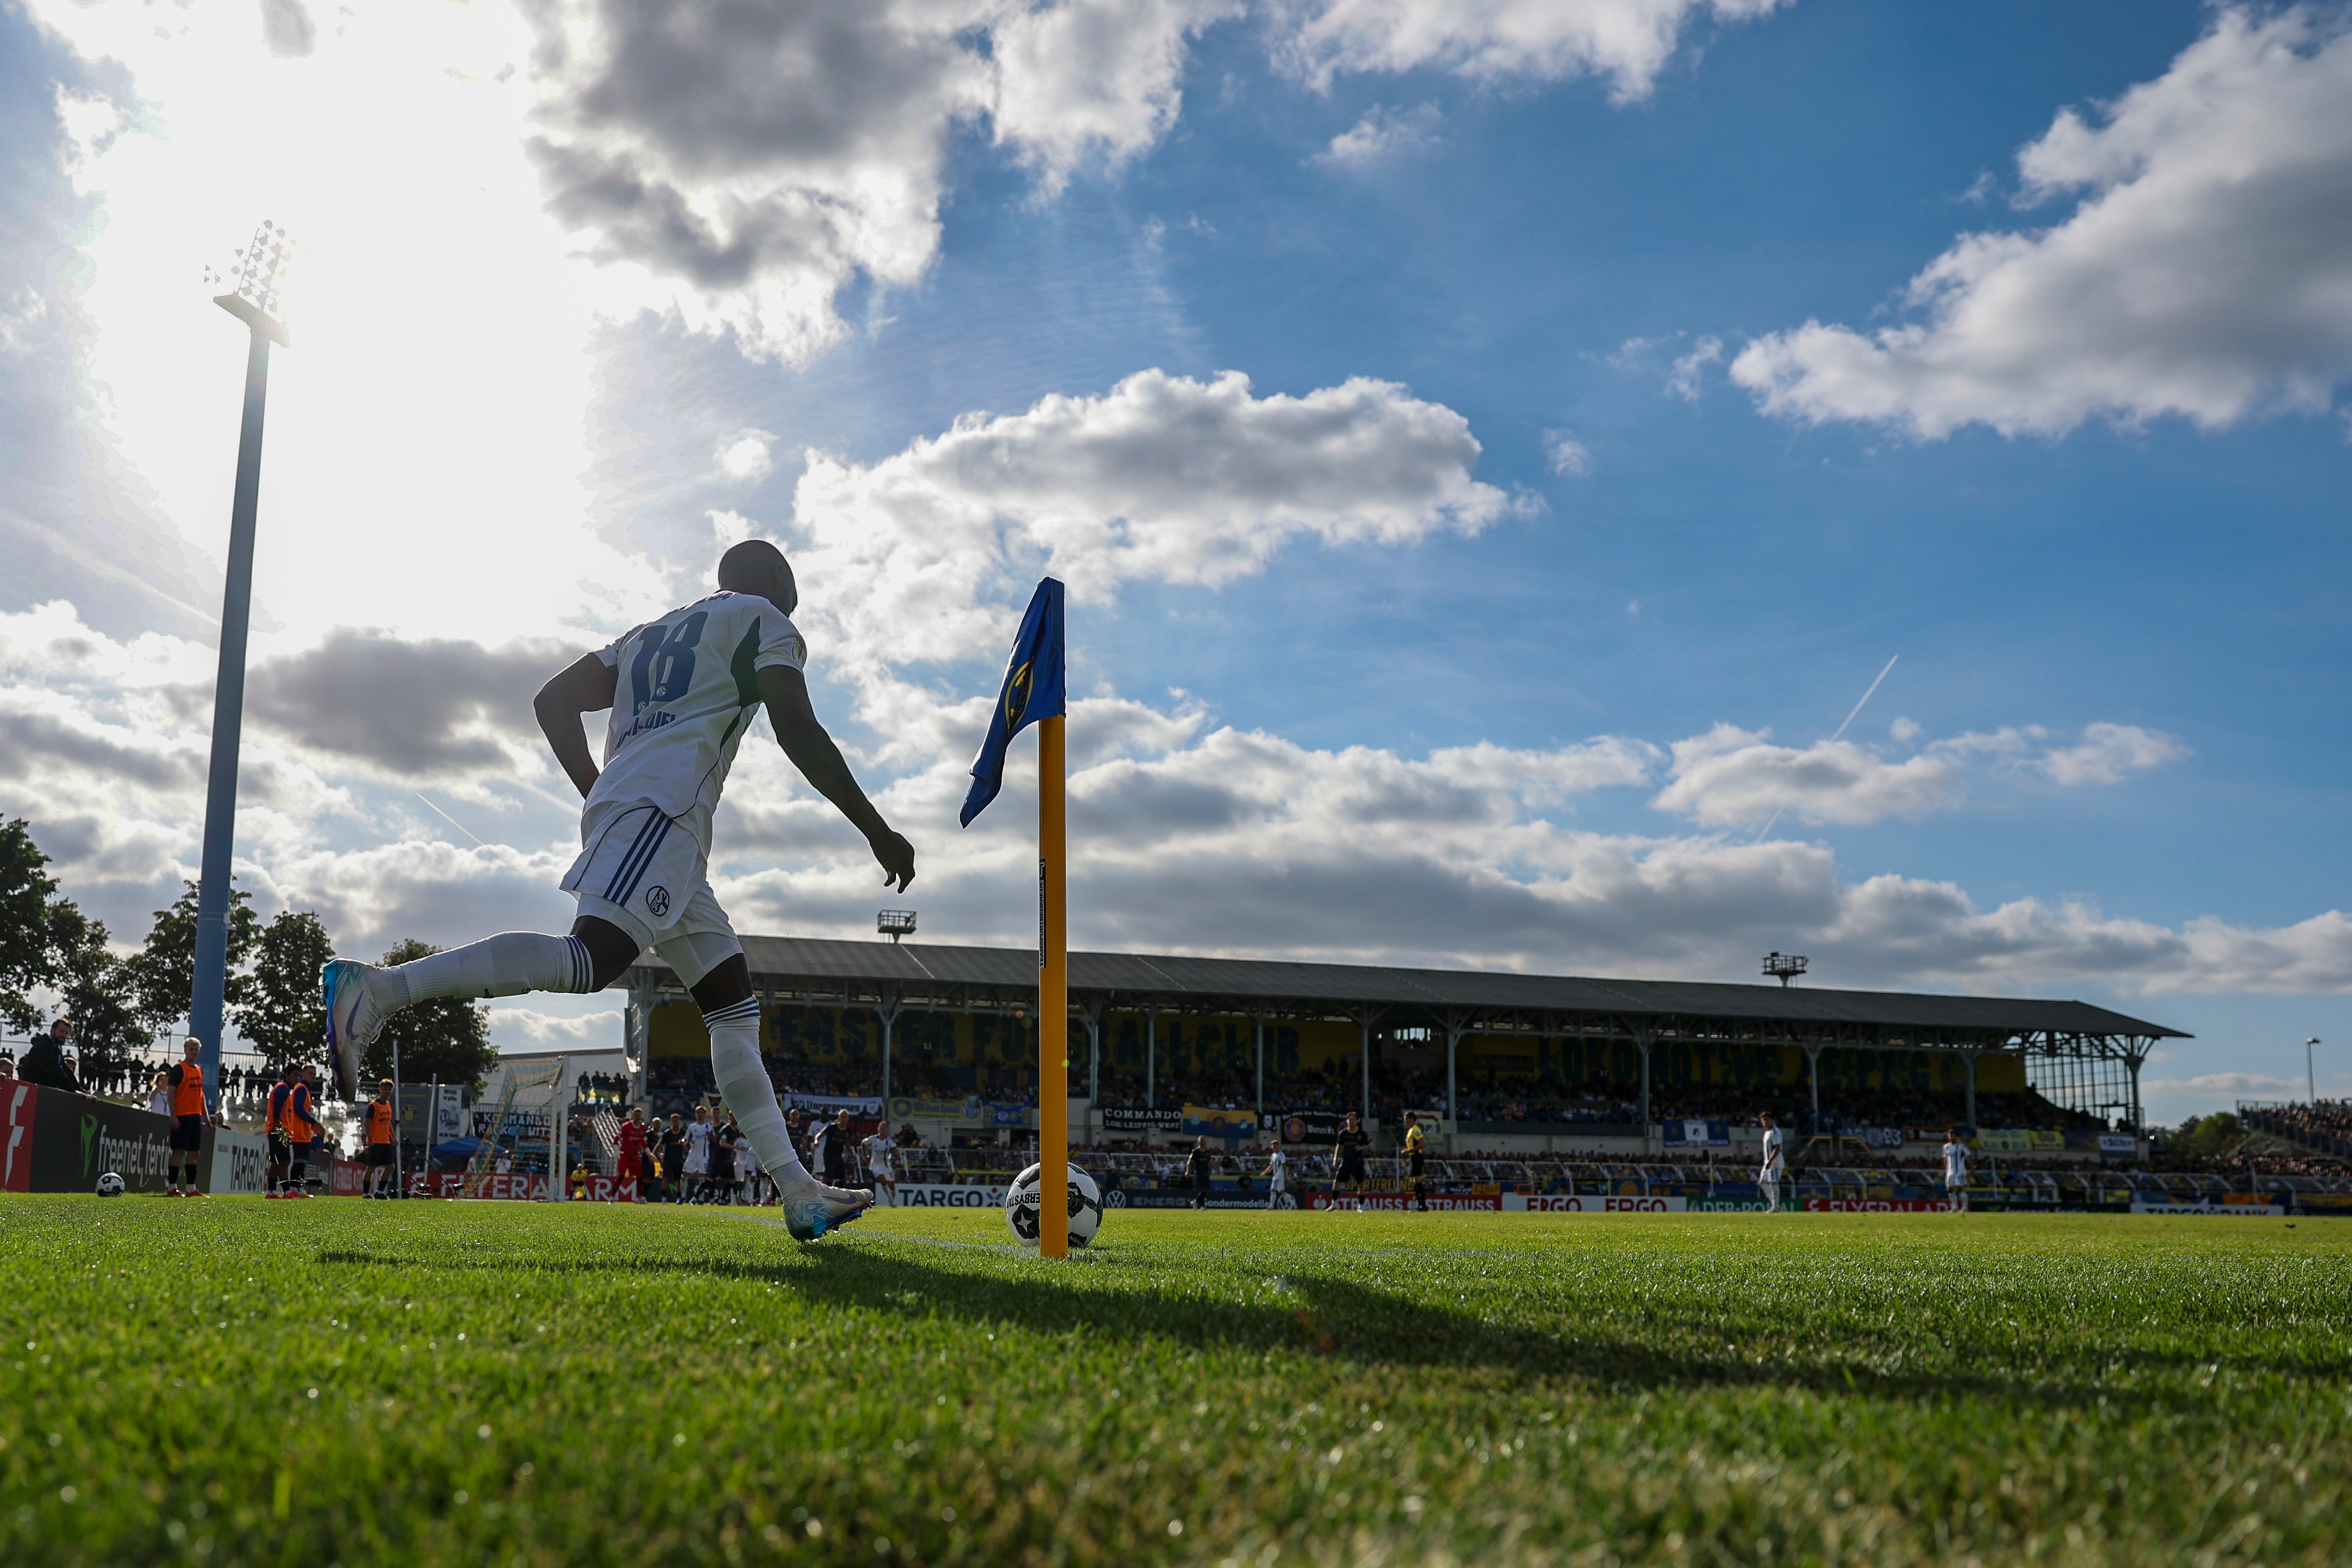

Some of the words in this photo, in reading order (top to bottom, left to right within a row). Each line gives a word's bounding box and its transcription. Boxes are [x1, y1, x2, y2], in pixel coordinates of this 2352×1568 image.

[632, 611, 708, 716] 18
[1105, 1108, 1181, 1120] COMMANDO
[441, 1174, 637, 1200] FLYERAARM
[1006, 1192, 1040, 1209] ERBYSTAR
[1426, 1199, 1495, 1211] STRAUSS
[1702, 1201, 1795, 1212] DFB-POAL
[1829, 1200, 1967, 1212] FLYERALAR
